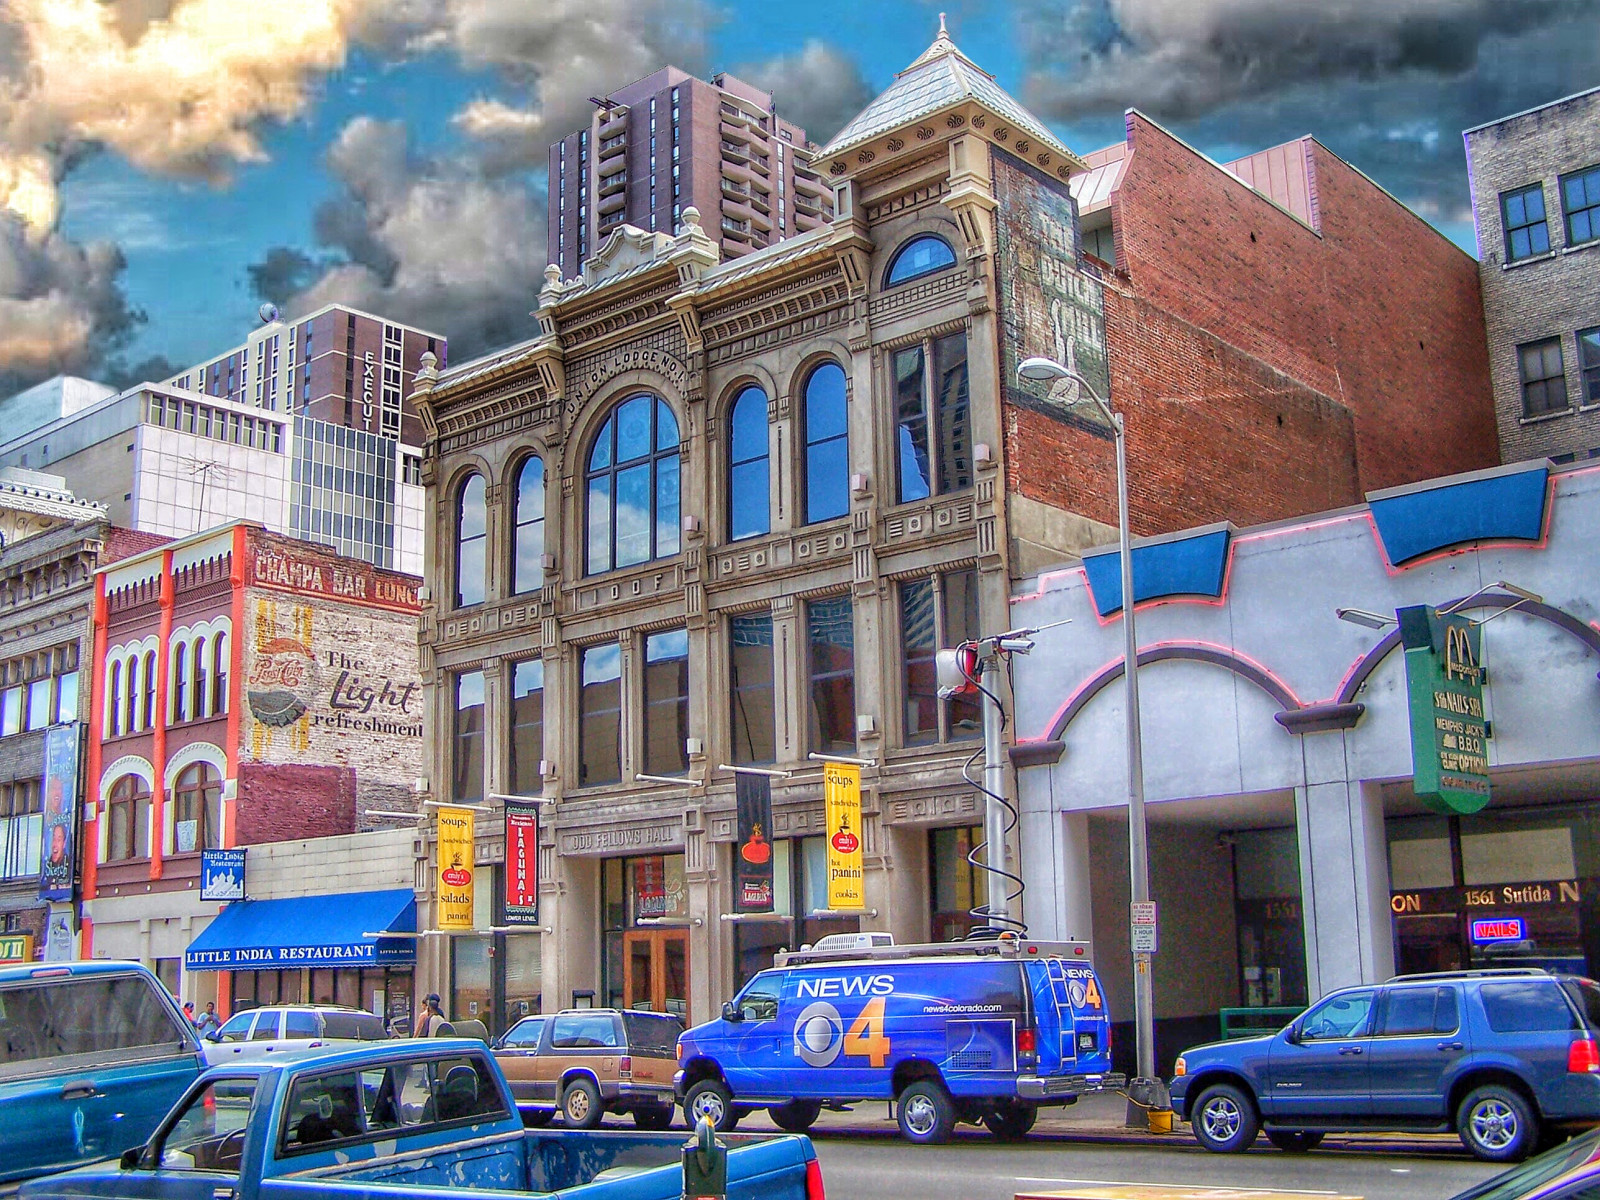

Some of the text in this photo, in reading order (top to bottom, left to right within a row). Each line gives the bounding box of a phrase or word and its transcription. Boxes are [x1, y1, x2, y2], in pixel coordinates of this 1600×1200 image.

[363, 350, 375, 431] EXECUT
[567, 364, 607, 414] UNION
[614, 351, 658, 368] LODGE
[256, 555, 323, 591] CHAMPA
[332, 568, 367, 600] BAR
[326, 650, 364, 670] The
[330, 670, 420, 714] Light
[1446, 691, 1469, 714] NAILS
[1436, 717, 1464, 734] MEMPHIS
[828, 776, 853, 788] soups
[441, 816, 468, 829] soups
[573, 826, 673, 850] ODD FELLOWS HALL
[832, 865, 861, 880] panini
[440, 893, 470, 904] salads
[835, 889, 859, 899] cookies
[1464, 890, 1496, 906] 1561
[1503, 885, 1551, 904] Sutida
[446, 912, 470, 921] panini
[1476, 922, 1519, 938] NAILS
[187, 944, 375, 963] LITTLE INDIA RESTAURANT
[1063, 968, 1094, 979] NEWS
[797, 974, 895, 998] NEWS
[1086, 978, 1101, 1009] 4
[923, 1004, 1002, 1013] news4colorado.com
[843, 996, 891, 1067] 4
